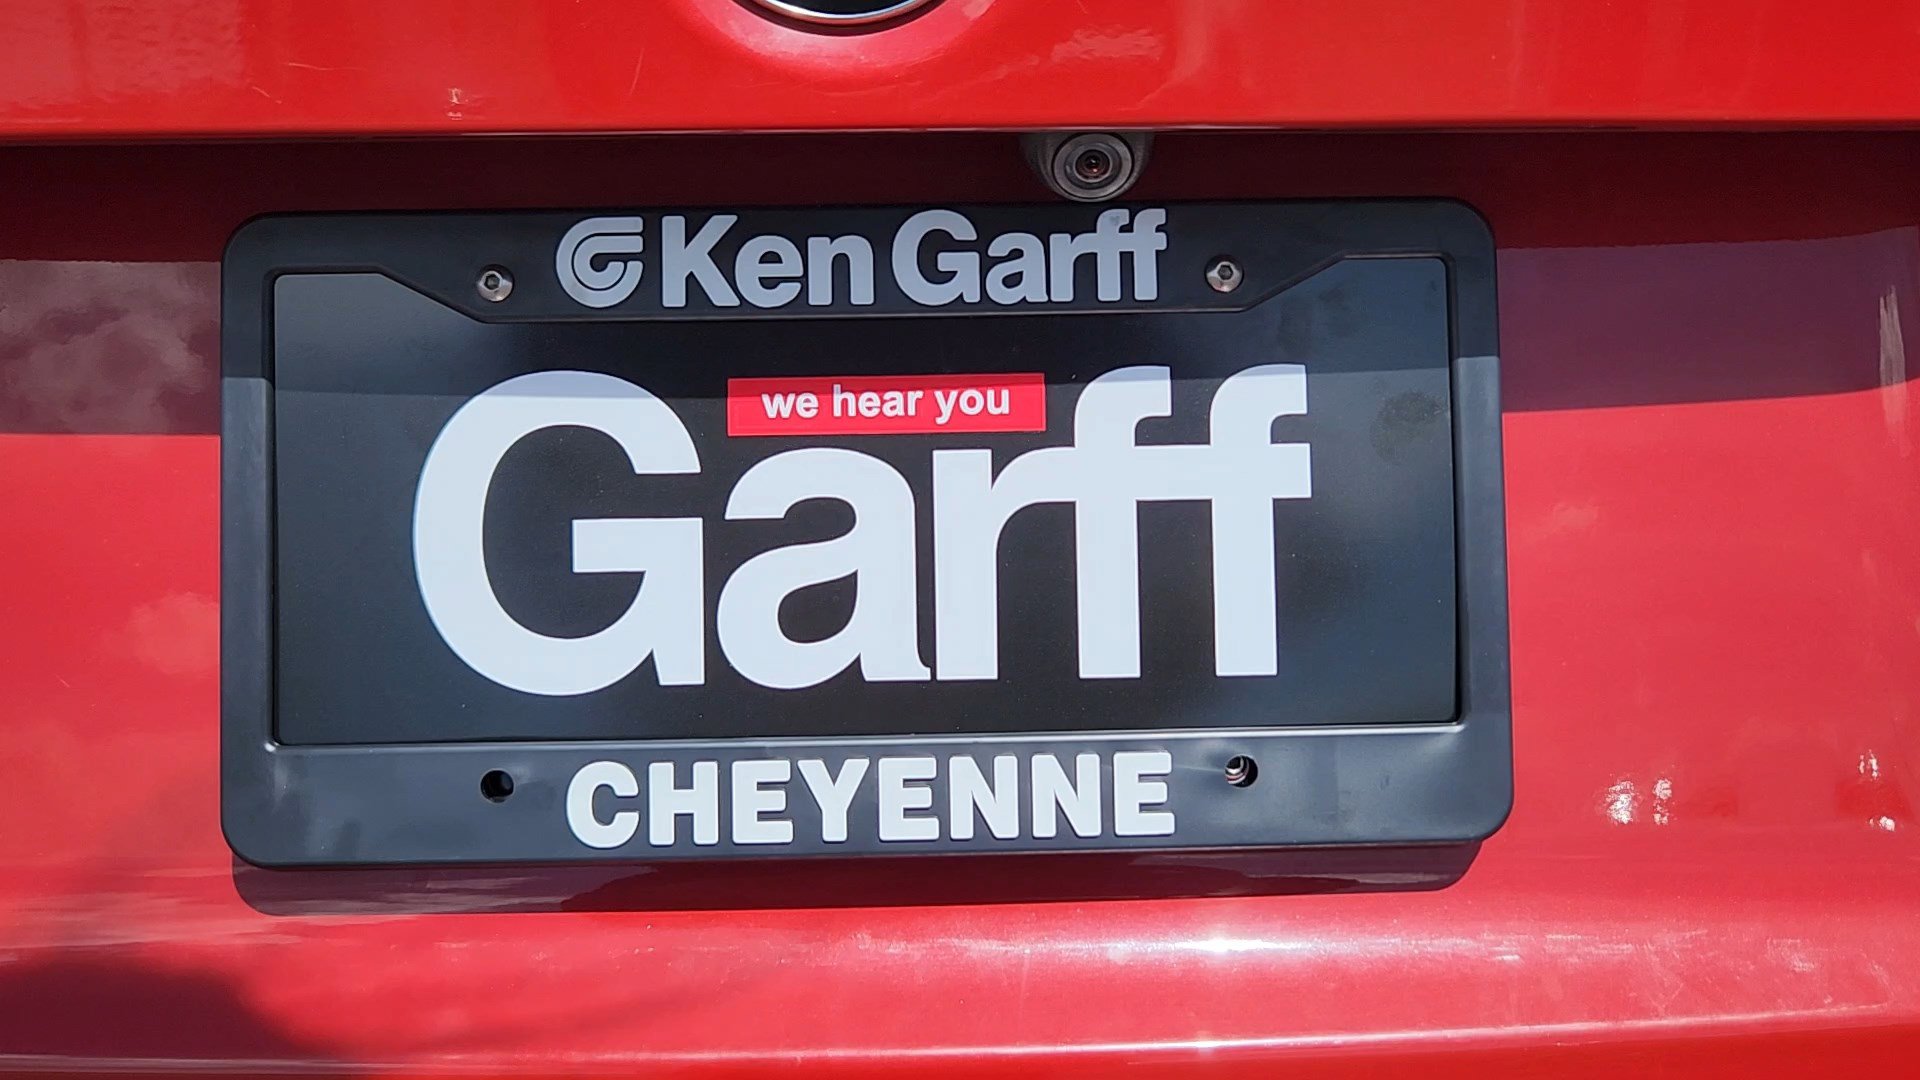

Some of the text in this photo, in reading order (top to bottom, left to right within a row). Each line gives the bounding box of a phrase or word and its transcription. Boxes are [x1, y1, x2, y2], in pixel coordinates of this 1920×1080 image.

[661, 207, 1167, 308] Ken Garff
[761, 384, 1010, 424] we hear you
[413, 364, 1312, 696] Garff
[566, 750, 1176, 849] CHEYENNE
